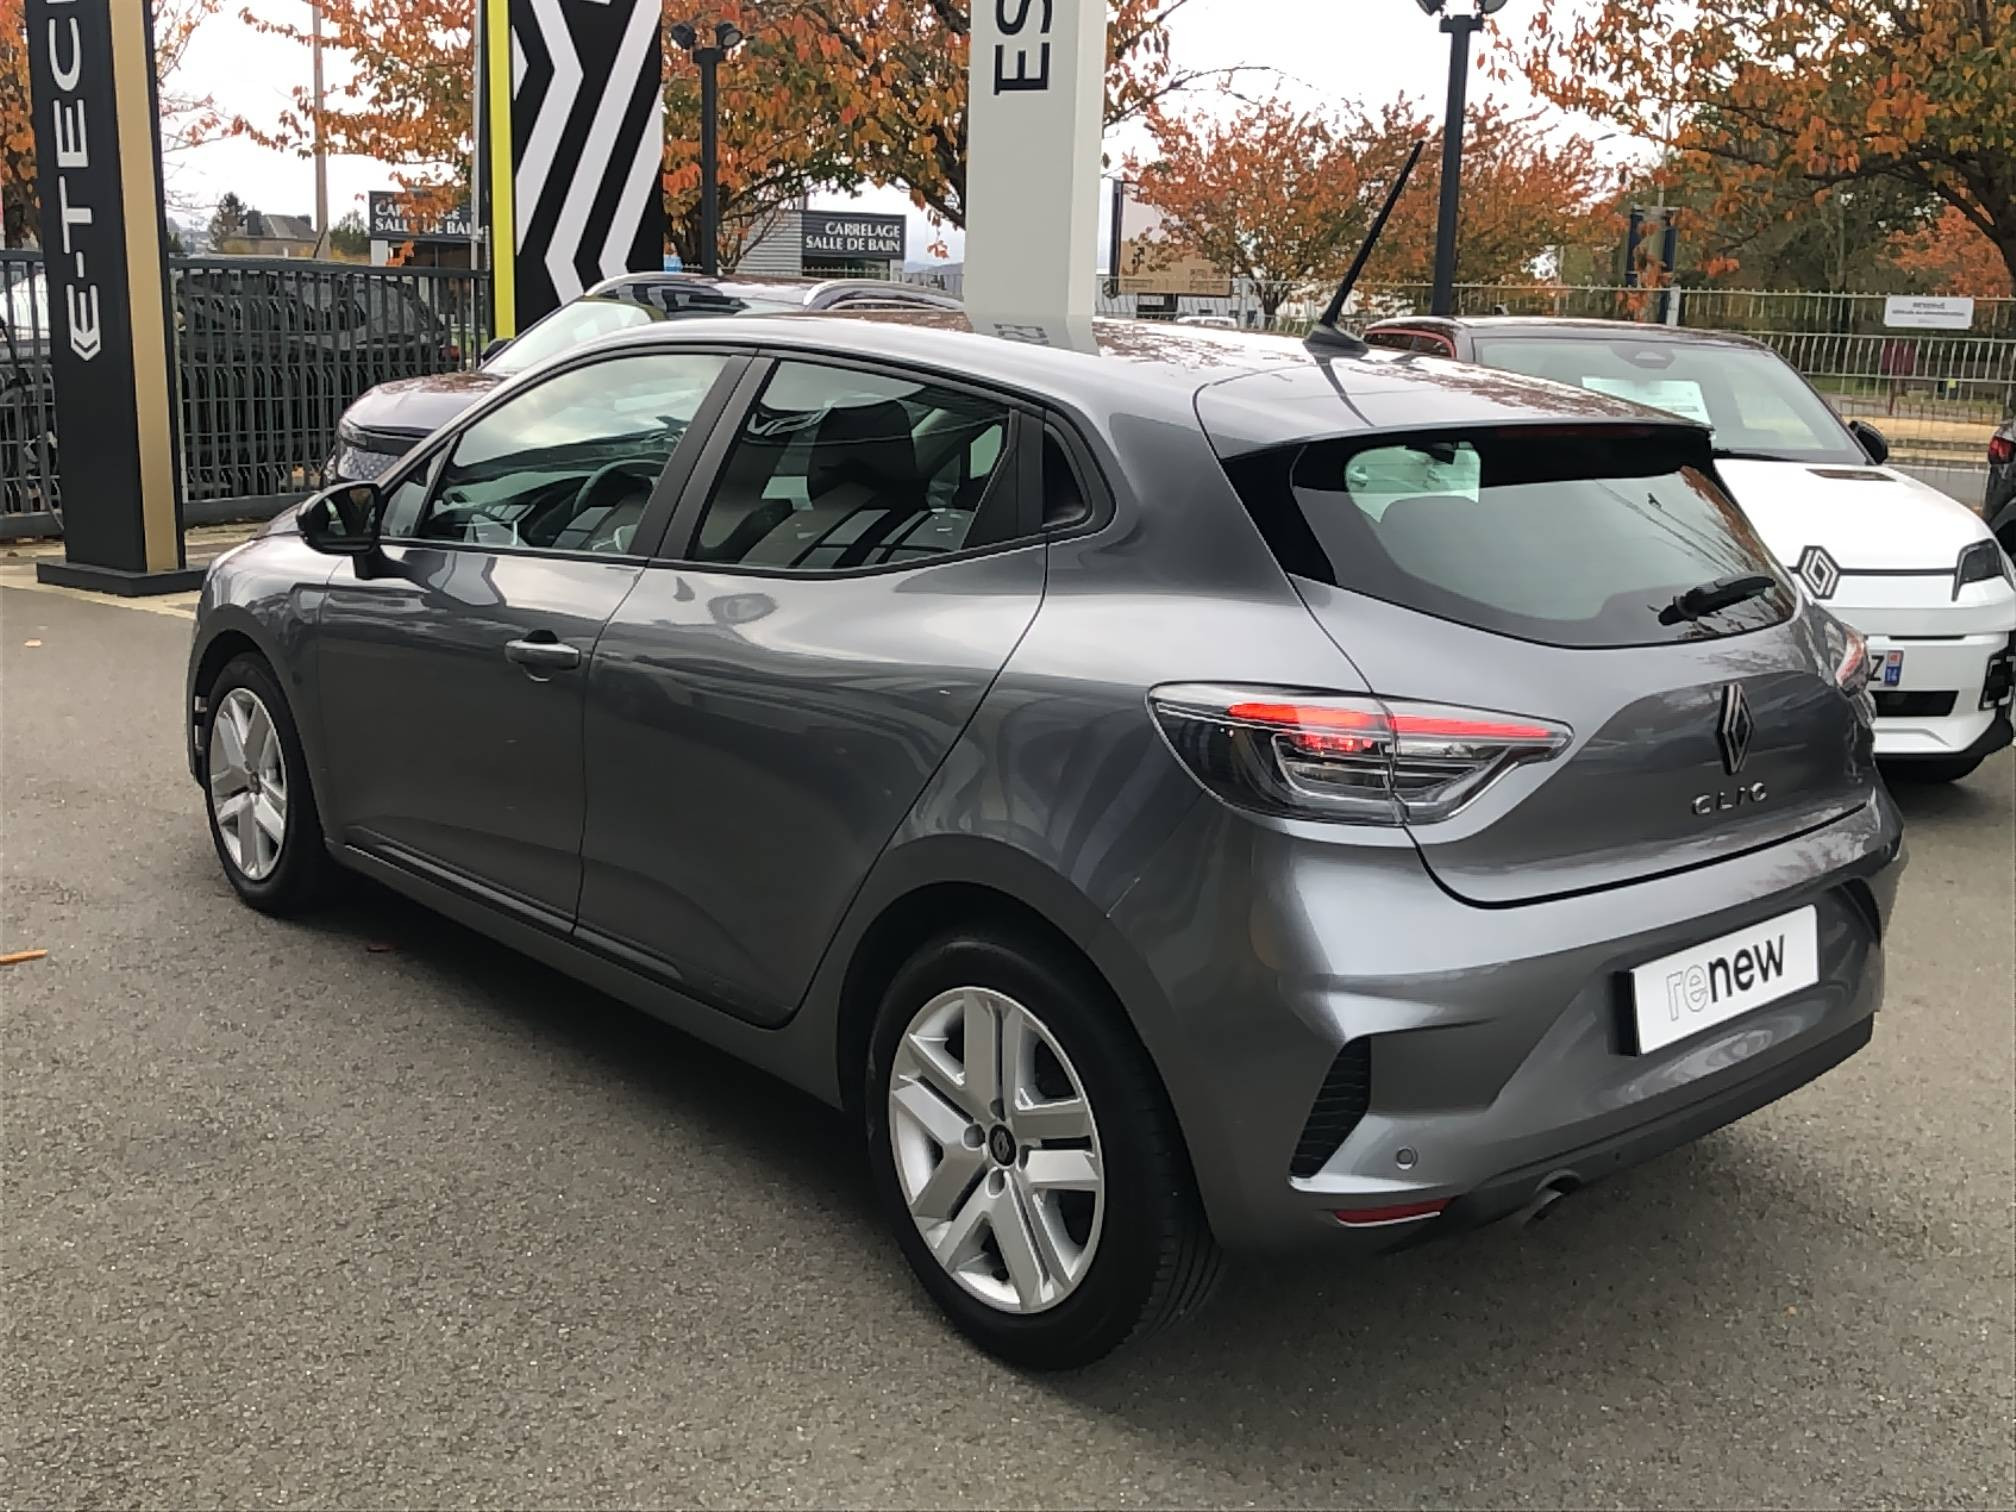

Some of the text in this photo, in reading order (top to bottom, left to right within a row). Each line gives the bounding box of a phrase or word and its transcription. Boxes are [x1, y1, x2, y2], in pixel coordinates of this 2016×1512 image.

[46, 0, 101, 361] E-TEC
[376, 218, 417, 233] SALL
[825, 221, 900, 238] CARRELAGE
[806, 235, 900, 251] SALLE DE BAIN
[1692, 782, 1768, 815] CLIO
[1666, 934, 1784, 1021] renew
